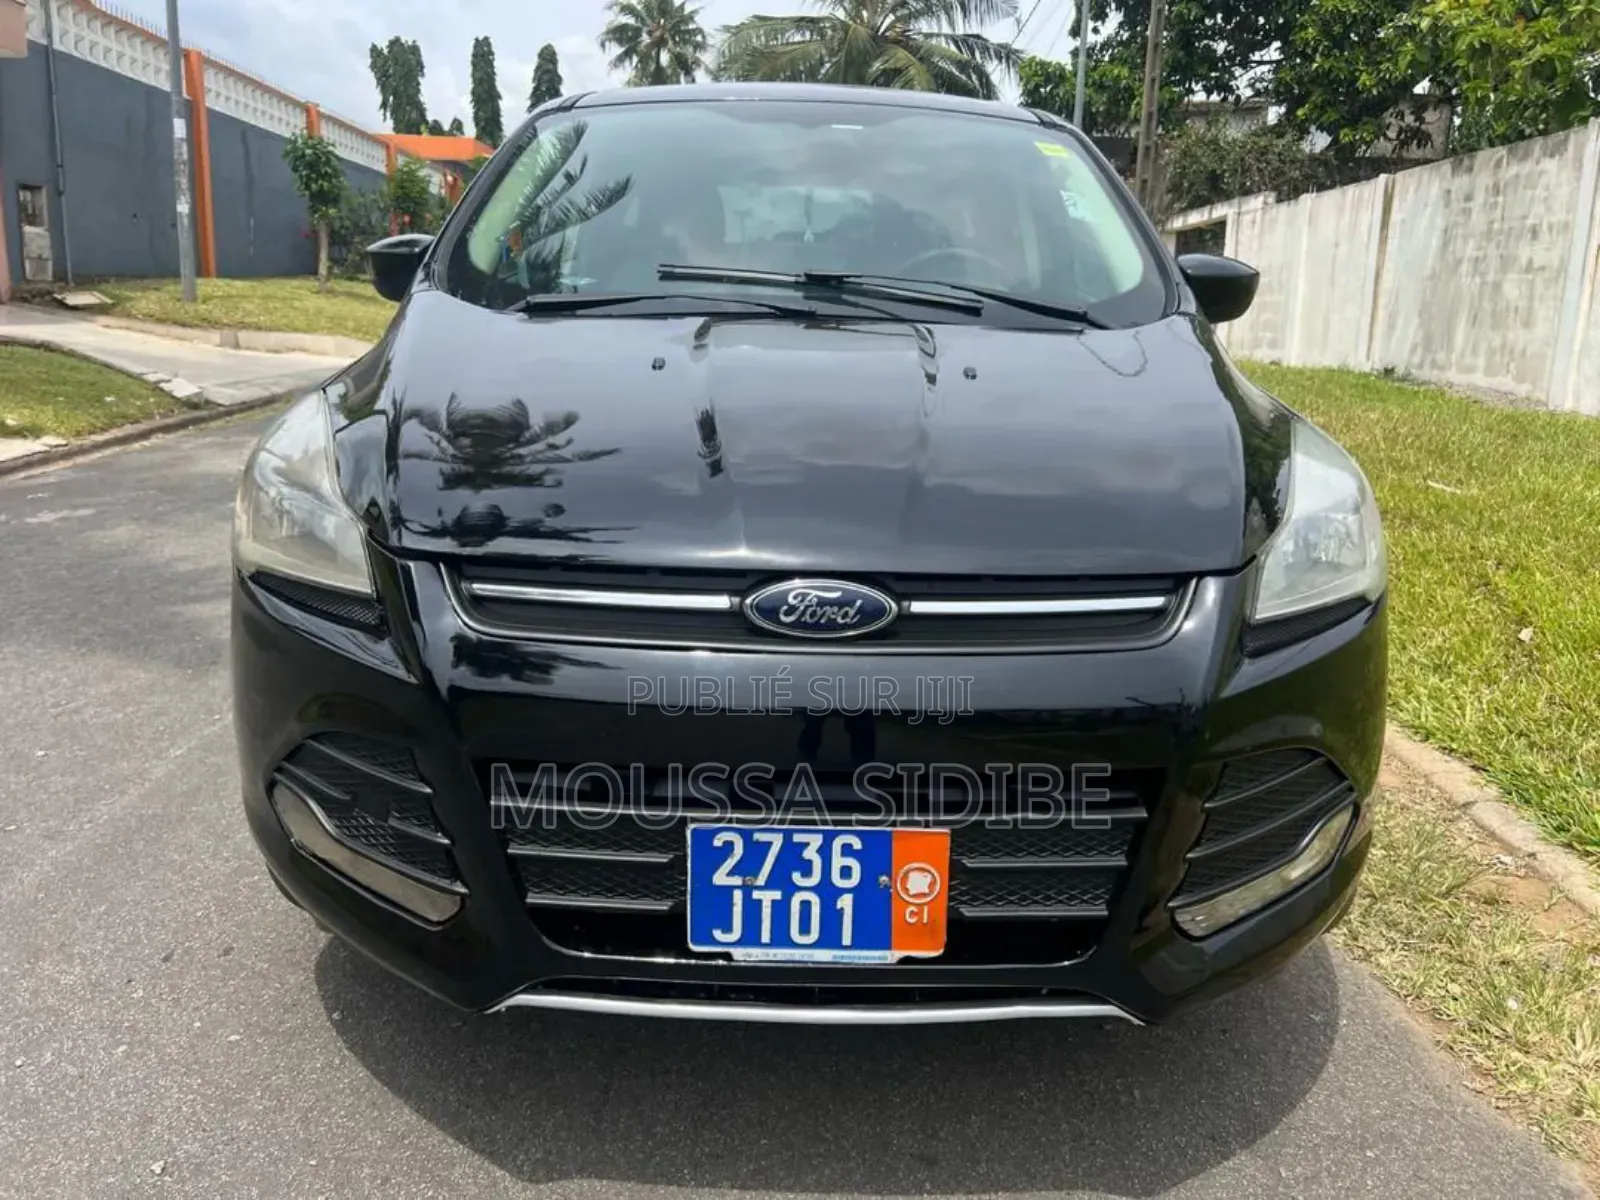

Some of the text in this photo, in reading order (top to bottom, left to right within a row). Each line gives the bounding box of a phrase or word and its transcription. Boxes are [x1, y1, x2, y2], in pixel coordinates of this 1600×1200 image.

[779, 589, 863, 624] Ford
[712, 832, 863, 888] 2736
[712, 889, 855, 946] JT01
[904, 906, 929, 924] CI
